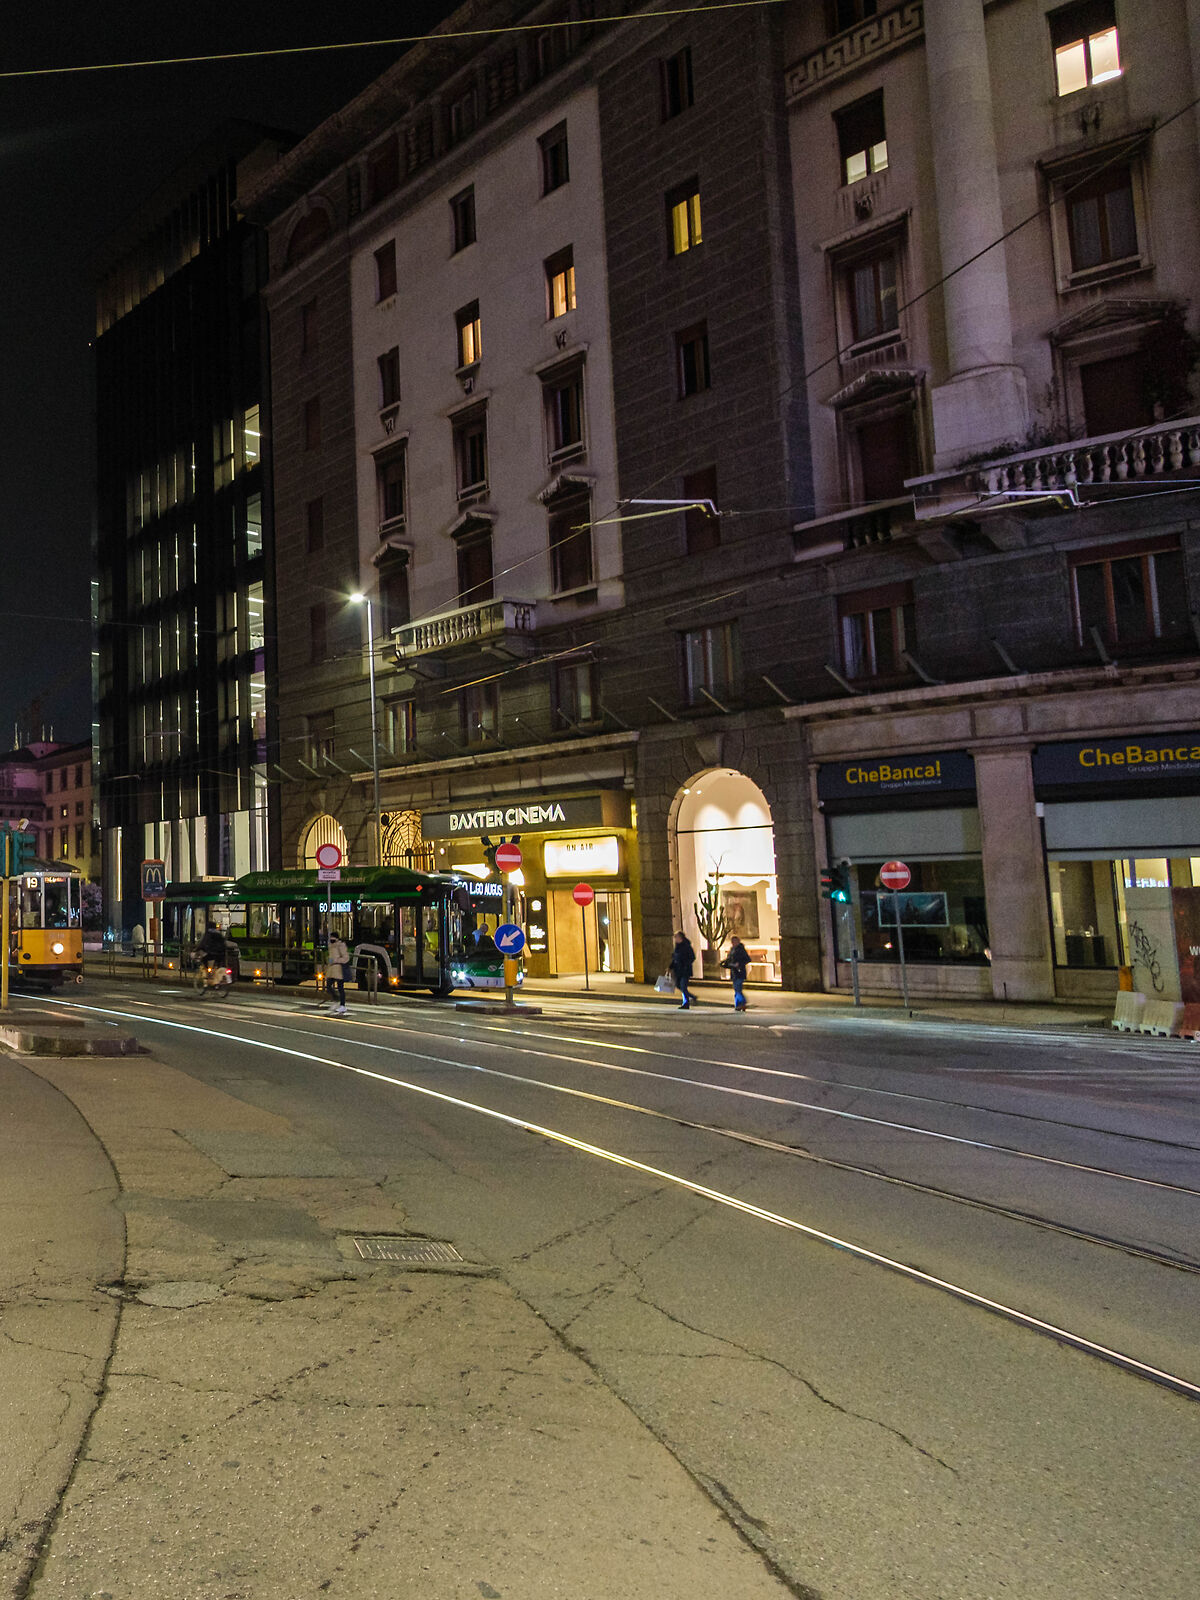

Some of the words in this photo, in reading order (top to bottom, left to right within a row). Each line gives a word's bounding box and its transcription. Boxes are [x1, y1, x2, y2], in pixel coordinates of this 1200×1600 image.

[846, 760, 941, 784] CheBanca!
[449, 810, 504, 831] BAXTER
[505, 803, 566, 826] CINEMA
[566, 844, 576, 852] ON
[580, 842, 593, 850] AIR
[26, 877, 38, 889] 19
[469, 881, 484, 895] L.GO
[319, 902, 328, 912] 60
